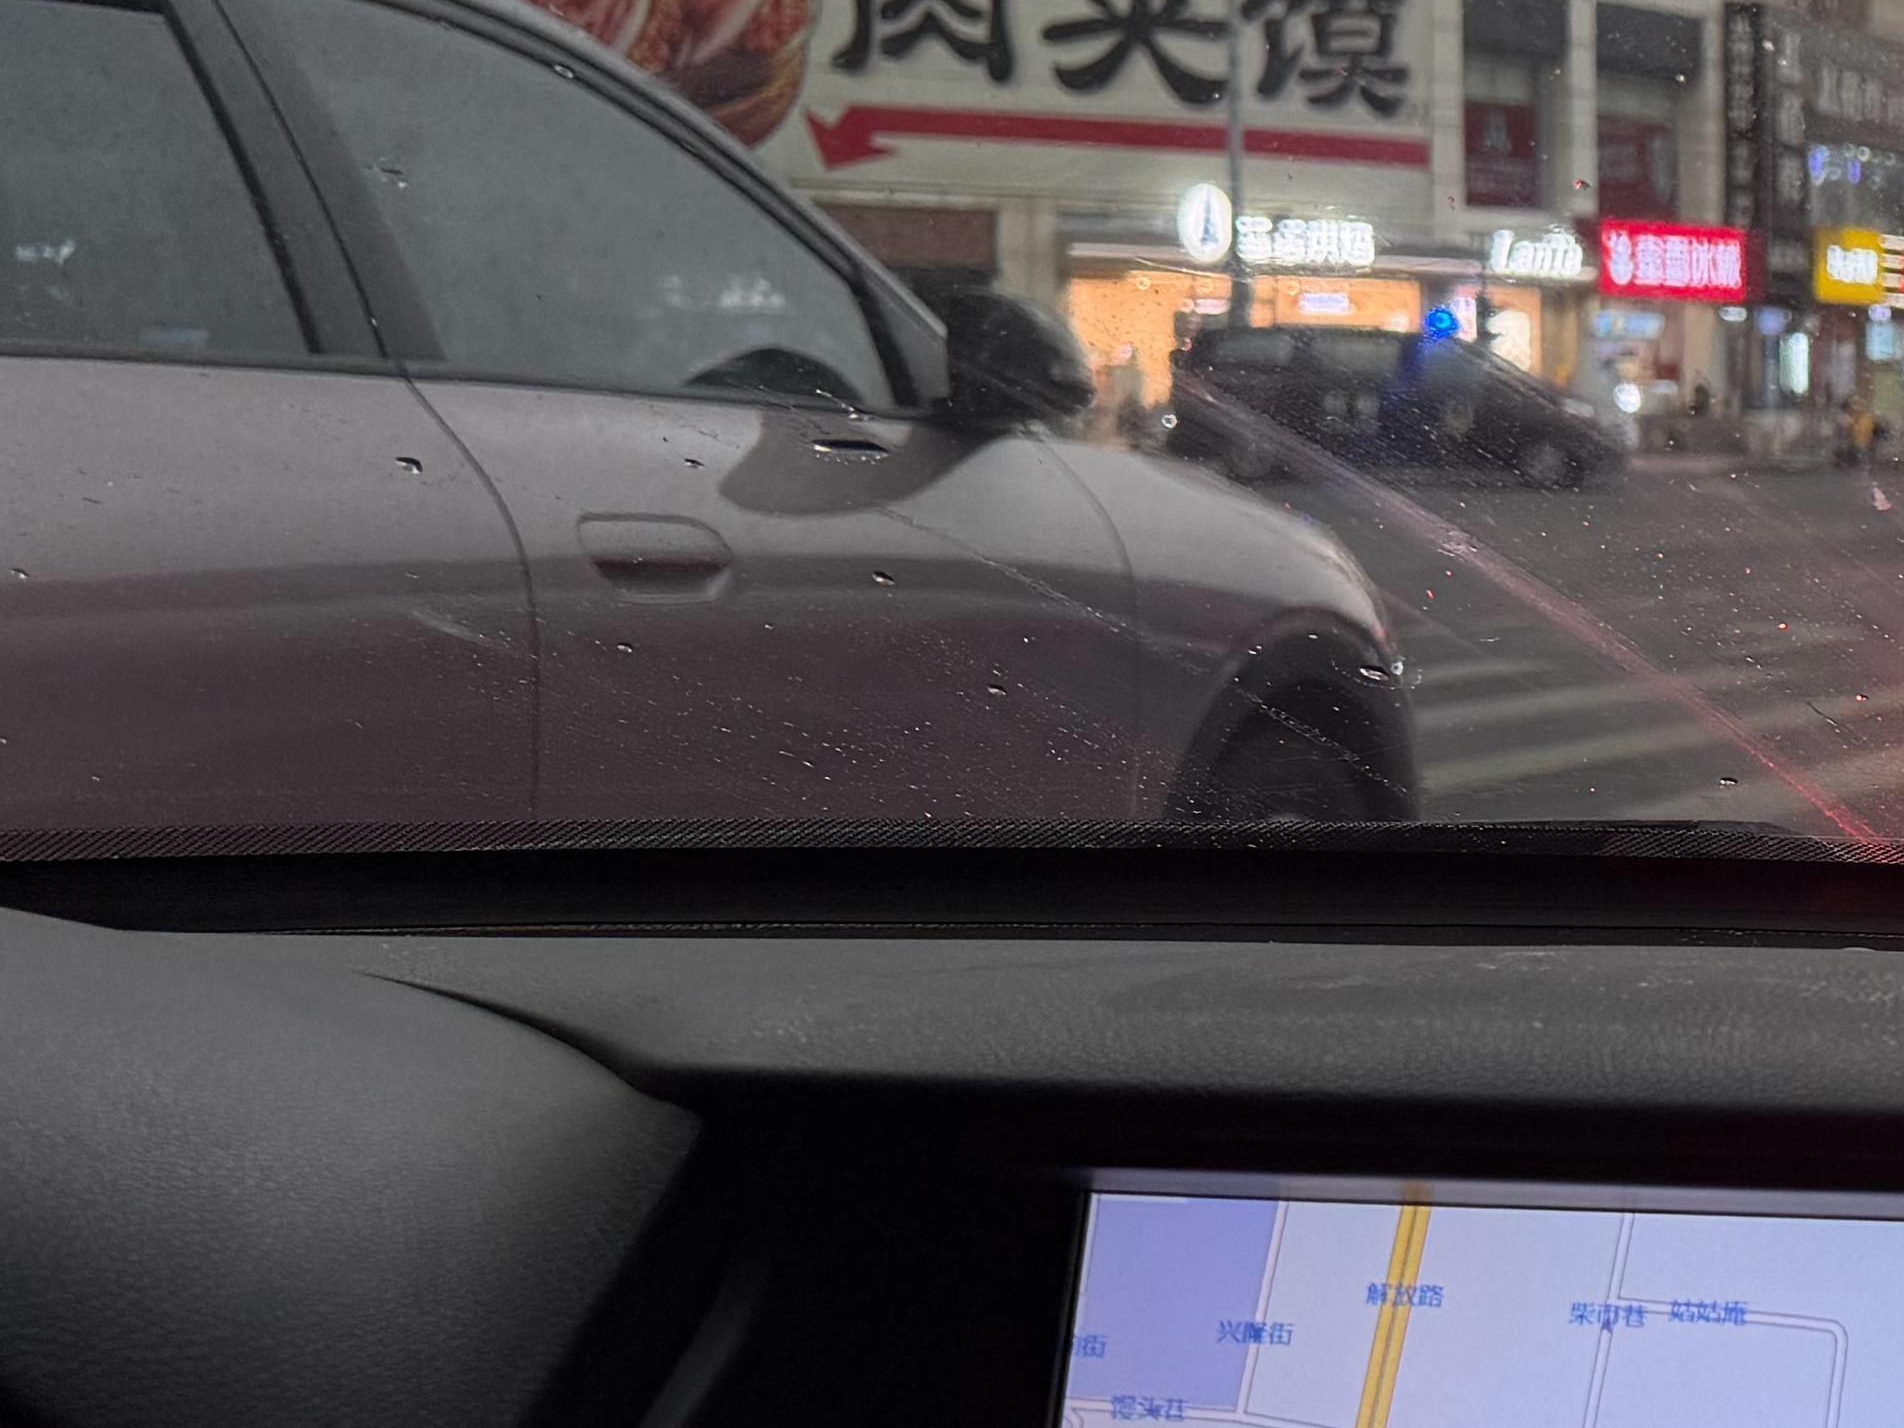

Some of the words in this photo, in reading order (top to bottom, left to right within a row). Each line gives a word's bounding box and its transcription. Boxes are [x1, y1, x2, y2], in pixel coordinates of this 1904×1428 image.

[1365, 1282, 1445, 1308] 解放路
[1569, 1302, 1649, 1328] 柴市巷
